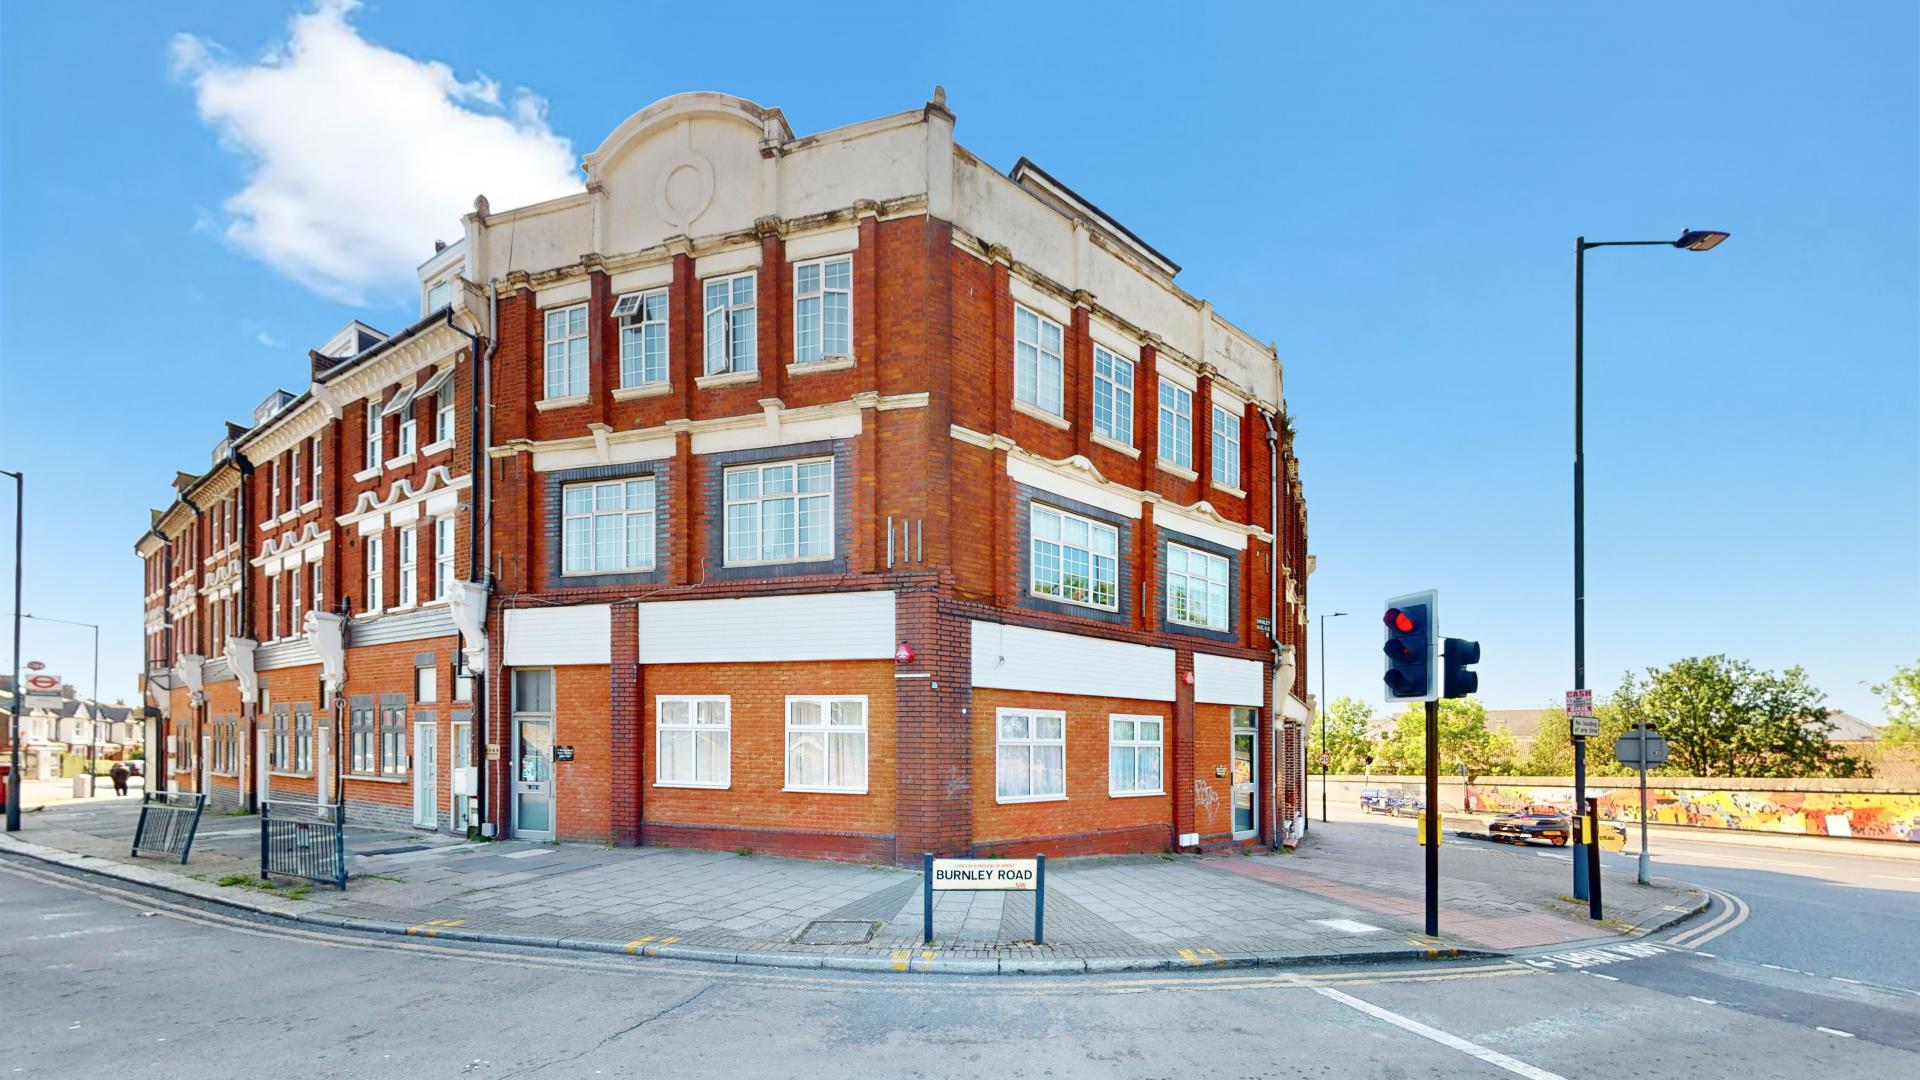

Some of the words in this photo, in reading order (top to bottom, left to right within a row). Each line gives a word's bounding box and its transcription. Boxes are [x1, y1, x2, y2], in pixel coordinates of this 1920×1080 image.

[1566, 690, 1592, 698] CASH
[936, 869, 993, 881] BURNLEY
[998, 869, 1033, 880] ROAD
